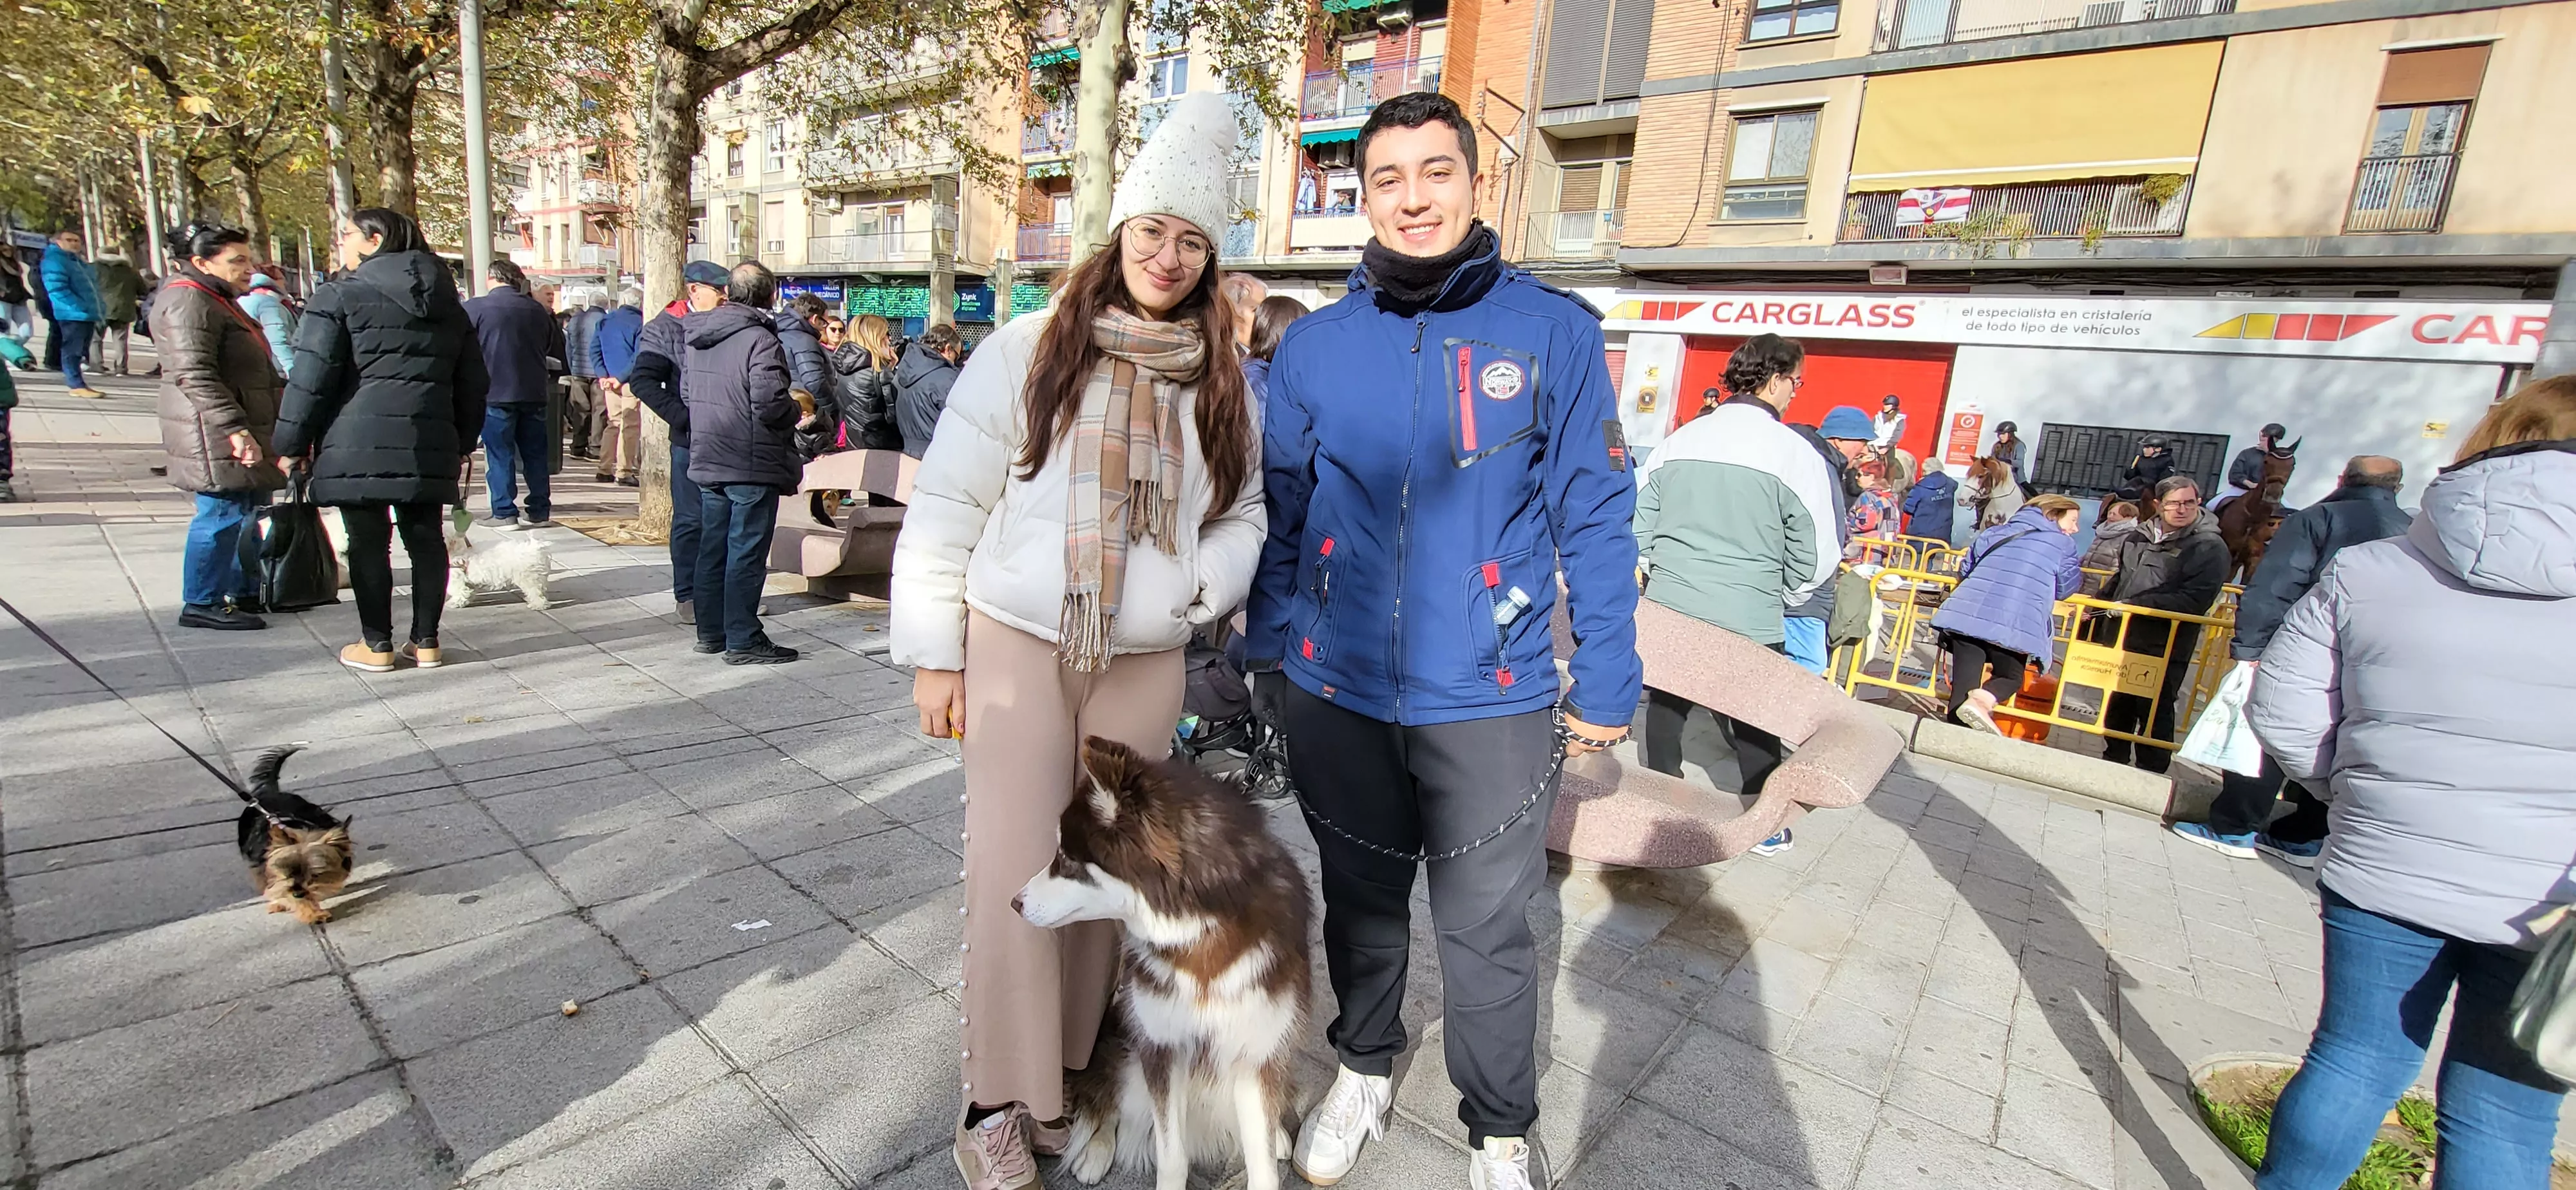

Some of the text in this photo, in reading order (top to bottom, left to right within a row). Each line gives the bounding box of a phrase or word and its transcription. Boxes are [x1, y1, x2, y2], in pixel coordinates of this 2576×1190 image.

[961, 293, 977, 301] Zynk
[1712, 301, 1917, 329] CARGLASS
[1962, 307, 2152, 321] el especialista en cristalería
[1965, 321, 2141, 335] de todo tipo de vehículos
